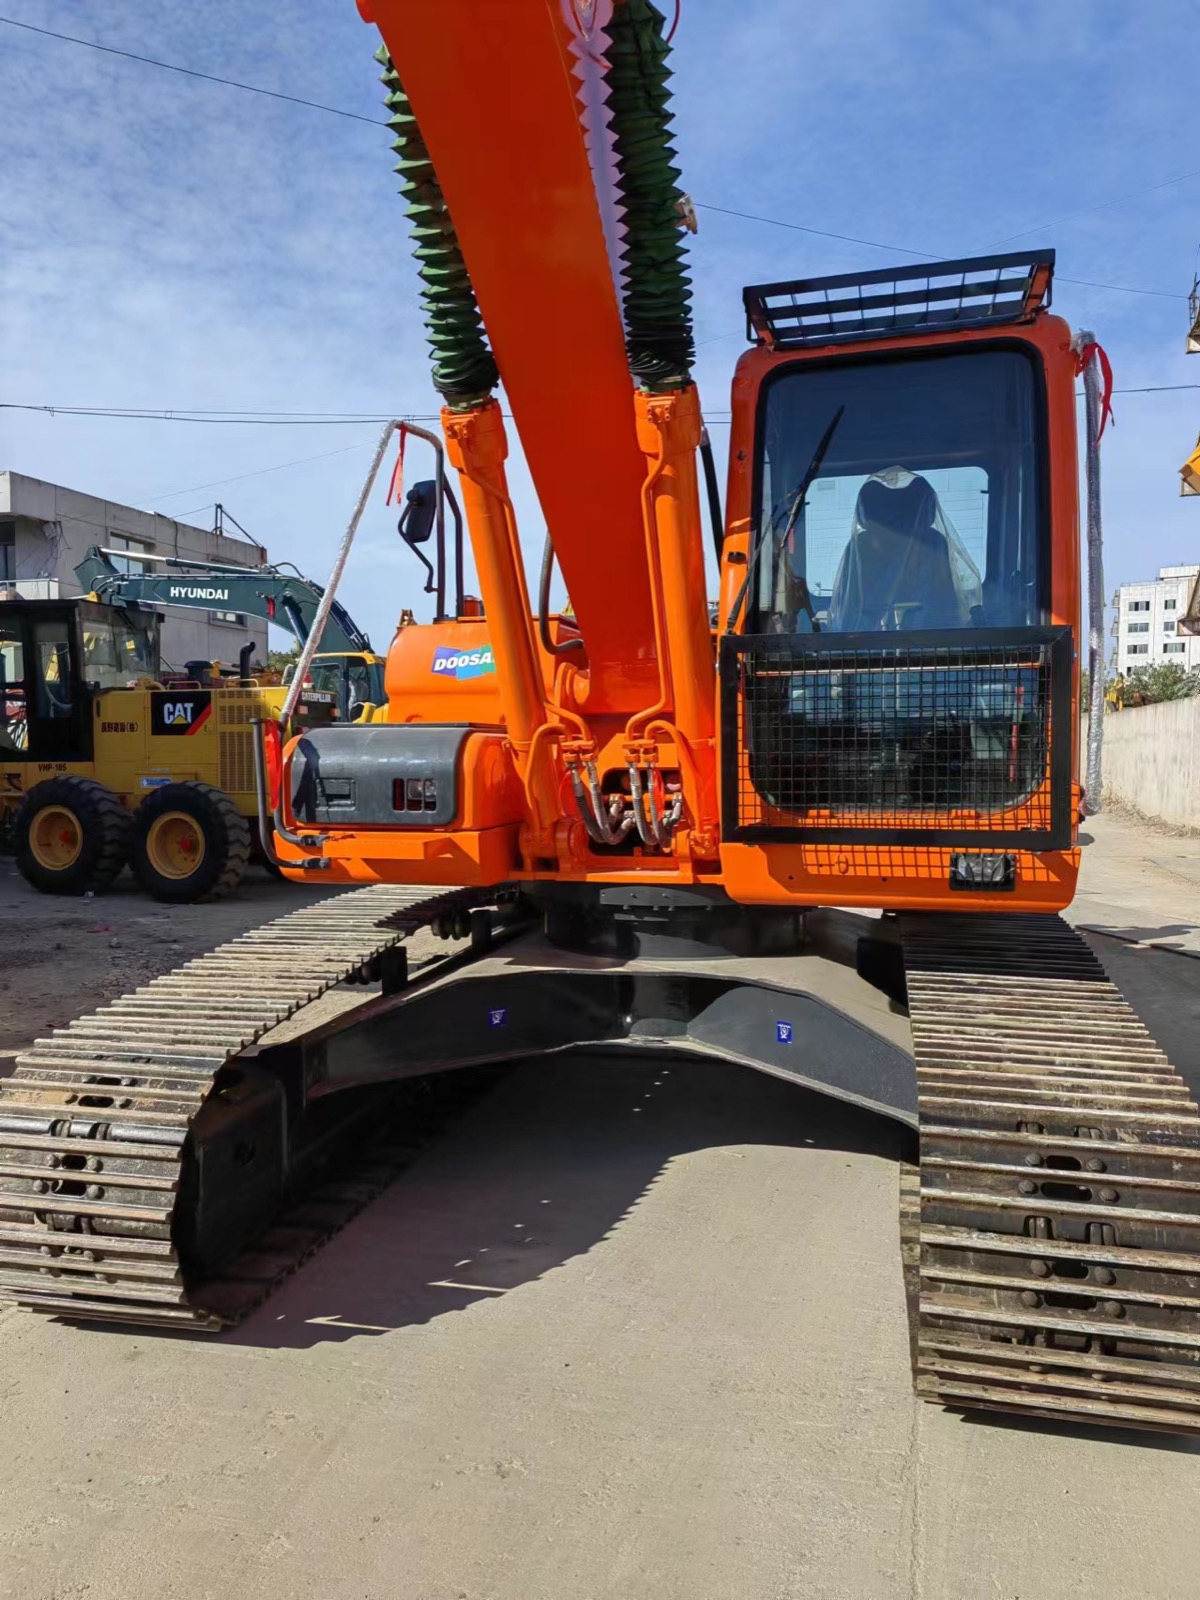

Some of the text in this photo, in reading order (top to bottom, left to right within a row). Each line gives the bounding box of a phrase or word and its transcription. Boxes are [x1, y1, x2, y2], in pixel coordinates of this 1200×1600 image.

[170, 587, 228, 600] HYUNDAI
[433, 652, 495, 672] DOOSA
[163, 703, 194, 724] CAT
